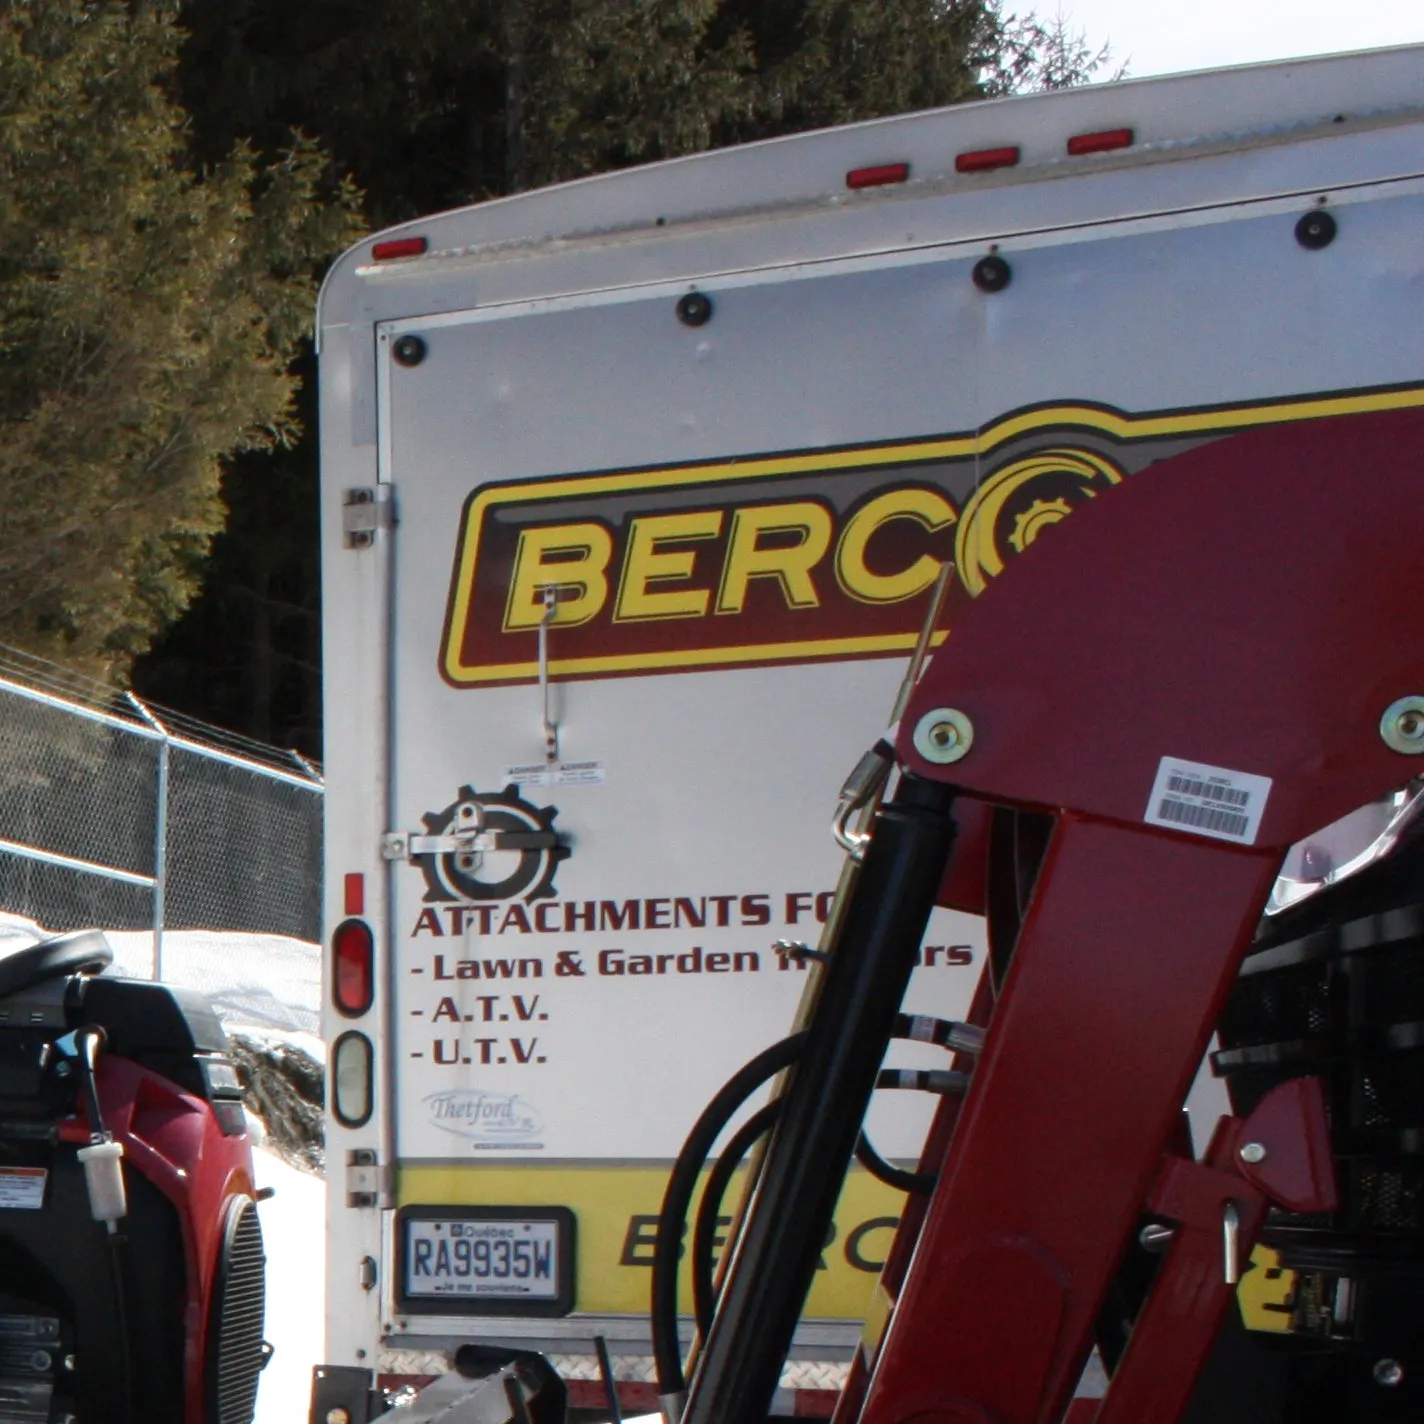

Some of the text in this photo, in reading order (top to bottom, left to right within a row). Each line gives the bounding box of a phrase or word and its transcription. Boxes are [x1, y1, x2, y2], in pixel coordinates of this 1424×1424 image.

[410, 894, 771, 938] ATTACHMENTS
[433, 954, 543, 981] Lawn
[554, 950, 586, 977] &
[598, 947, 760, 977] Garden
[432, 994, 549, 1023] A.T.V.
[433, 1037, 547, 1065] U.T.V.
[430, 1094, 519, 1125] Thetford
[464, 1226, 515, 1238] Québec
[413, 1238, 551, 1279] RA9935W
